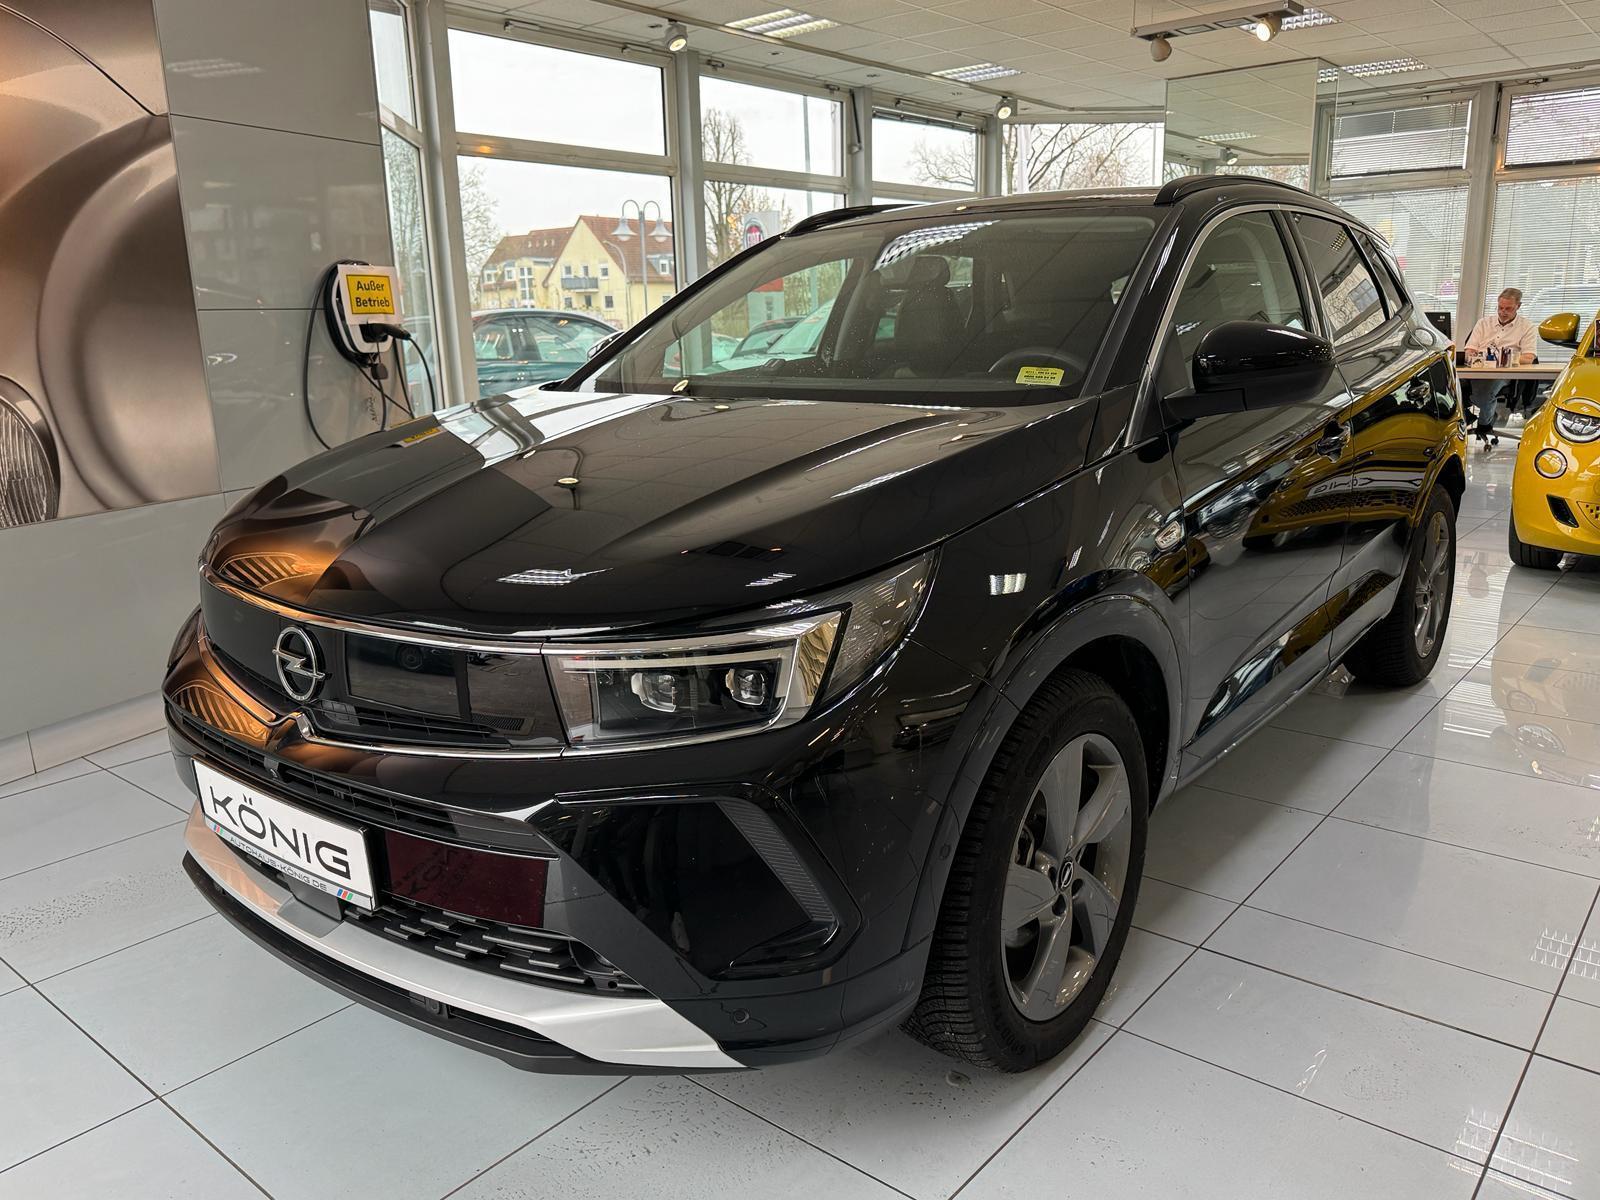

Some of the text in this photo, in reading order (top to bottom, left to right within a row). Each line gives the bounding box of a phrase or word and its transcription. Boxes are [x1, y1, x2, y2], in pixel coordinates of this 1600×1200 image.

[356, 280, 385, 291] Außer
[355, 297, 390, 307] Betrieb
[209, 785, 352, 880] KÖNIG
